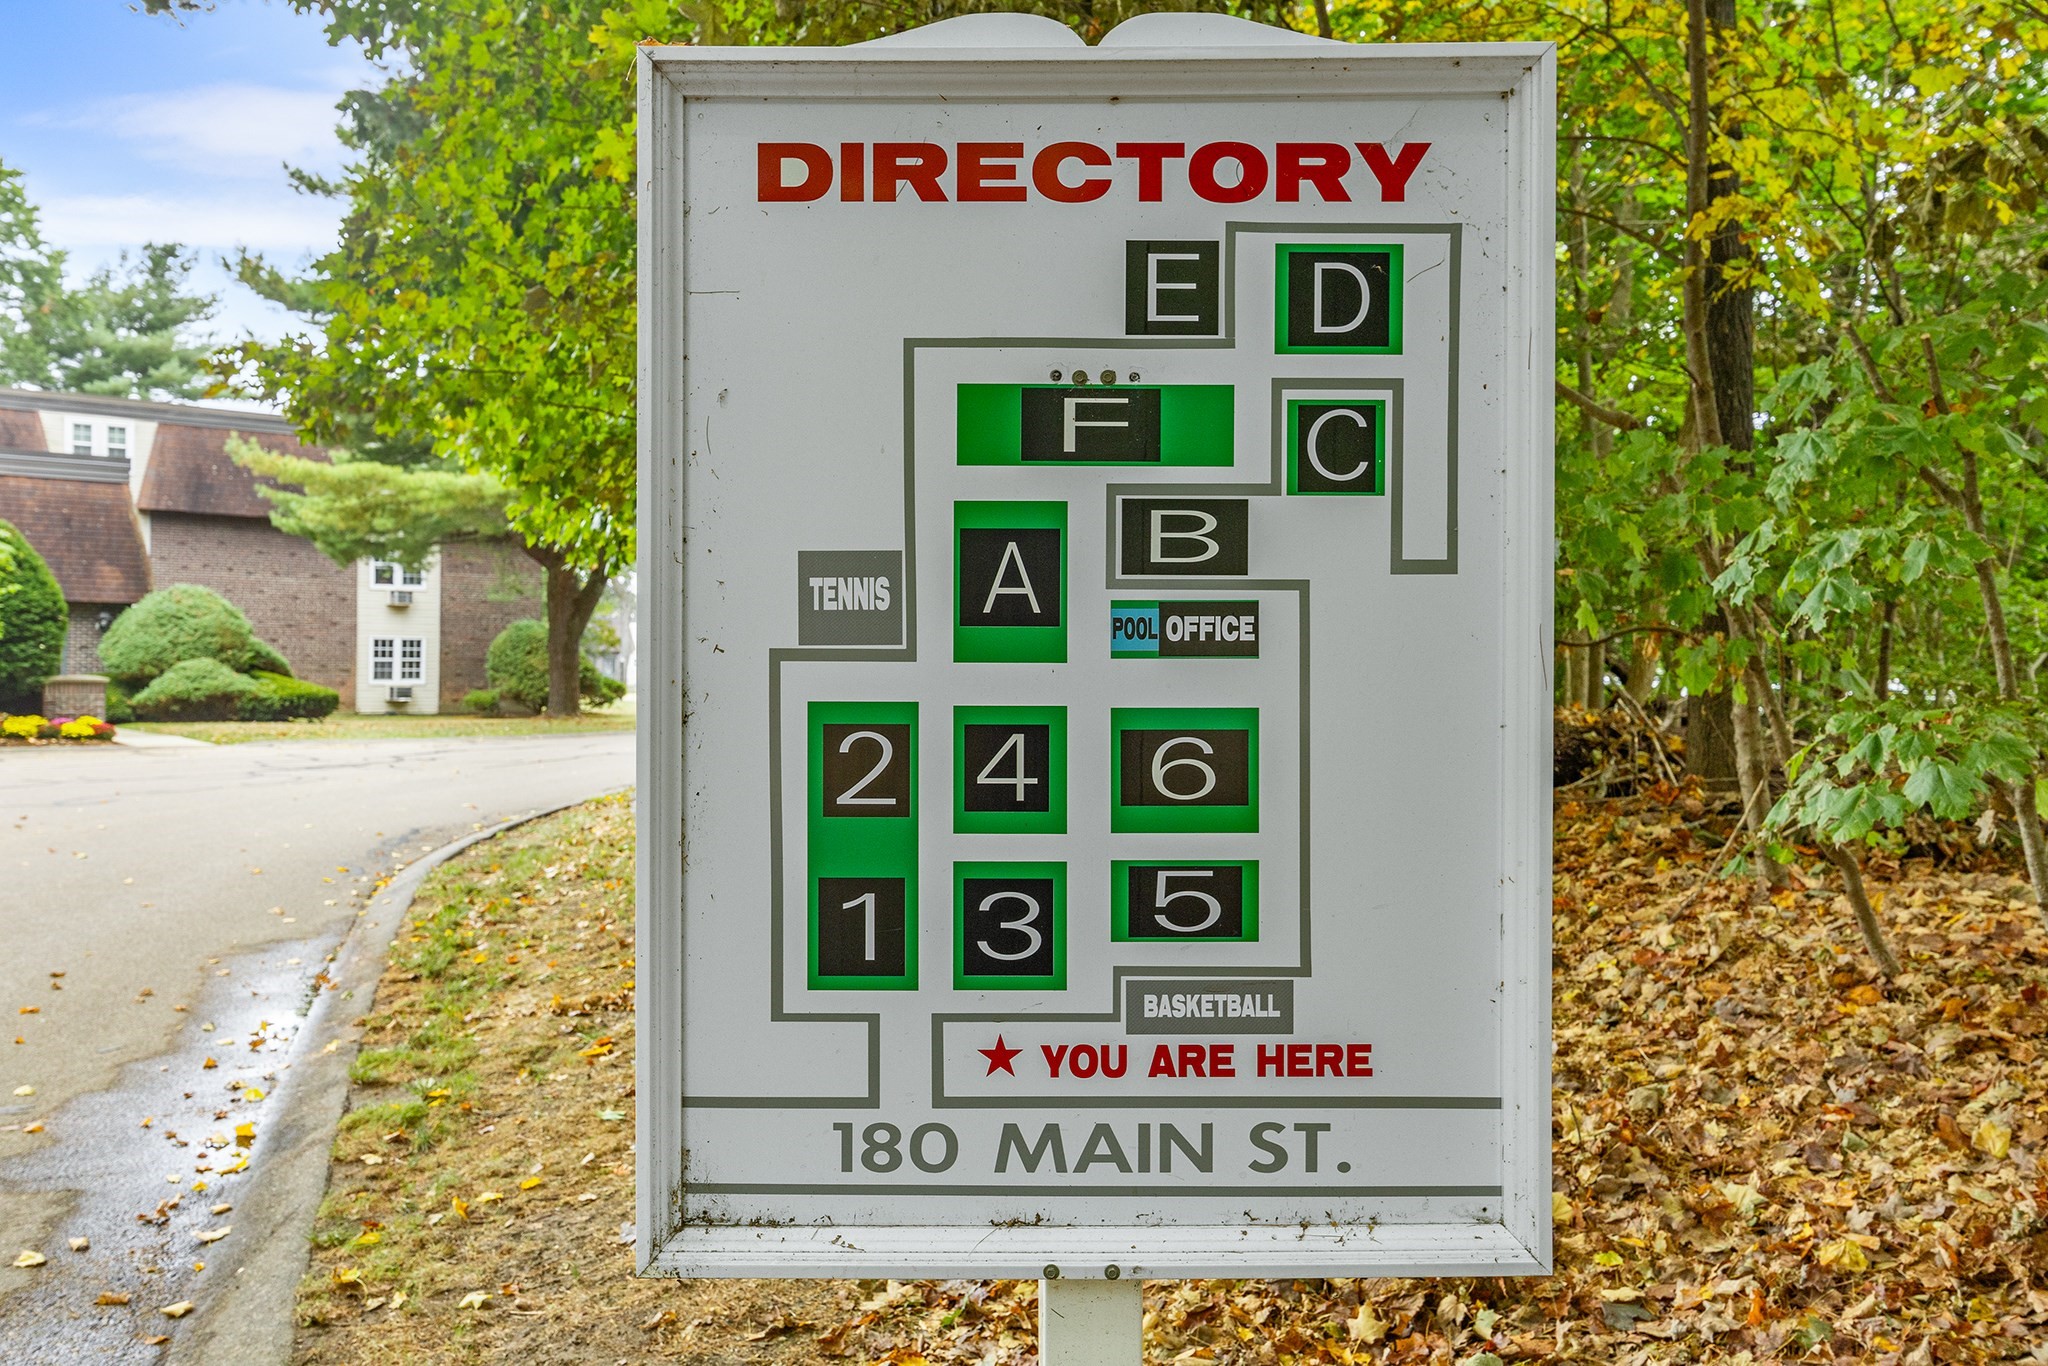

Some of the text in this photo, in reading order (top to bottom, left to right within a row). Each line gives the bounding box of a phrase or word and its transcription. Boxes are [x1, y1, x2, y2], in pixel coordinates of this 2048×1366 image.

[756, 141, 1432, 203] DIRECTORY
[1147, 253, 1200, 322] E
[1314, 262, 1370, 334] D
[1064, 397, 1129, 453] F
[1307, 408, 1370, 481] C
[1150, 509, 1219, 562] B
[809, 576, 890, 611] TENNIS
[983, 541, 1041, 614] A
[1113, 616, 1158, 640] POOL
[1166, 615, 1256, 642] OFFICE
[836, 730, 897, 805] 2
[976, 733, 1038, 802] 4
[1151, 736, 1216, 801] 6
[841, 892, 876, 962] 1
[977, 891, 1042, 961] 3
[1154, 871, 1220, 933] 5
[1144, 993, 1280, 1019] BASKETBALL
[1041, 1043, 1373, 1079] YOU ARE HERE
[833, 1122, 1352, 1175] 180 MAIN ST.
